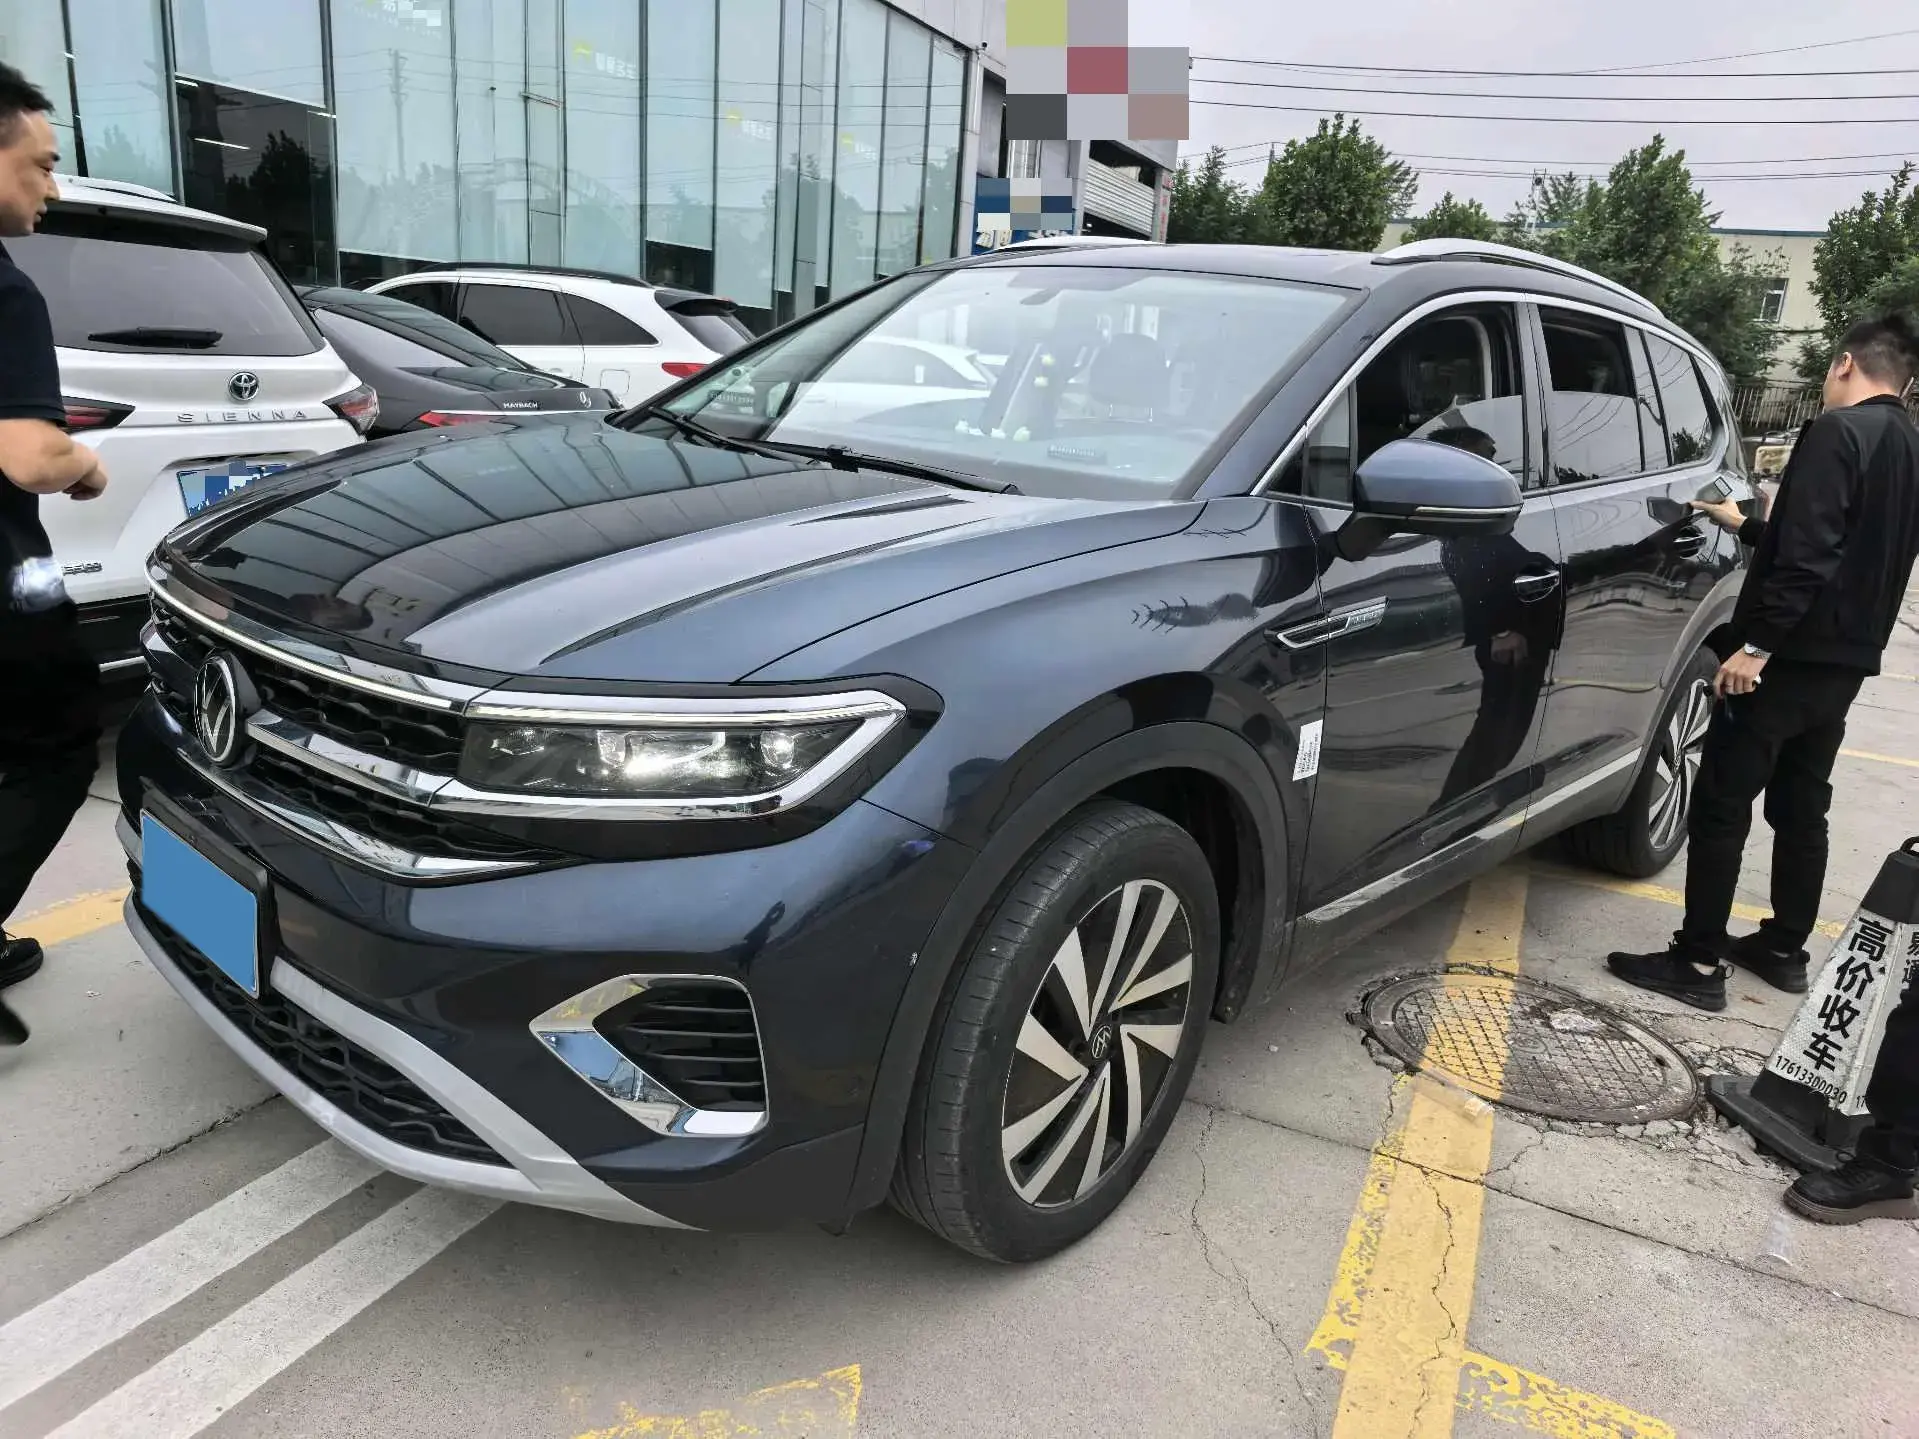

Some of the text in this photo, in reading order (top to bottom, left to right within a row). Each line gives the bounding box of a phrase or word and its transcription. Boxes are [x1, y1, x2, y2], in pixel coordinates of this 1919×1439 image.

[177, 409, 307, 423] SIENNA
[1803, 917, 1894, 1073] 高价收车
[1775, 1055, 1847, 1104] 17613300030
